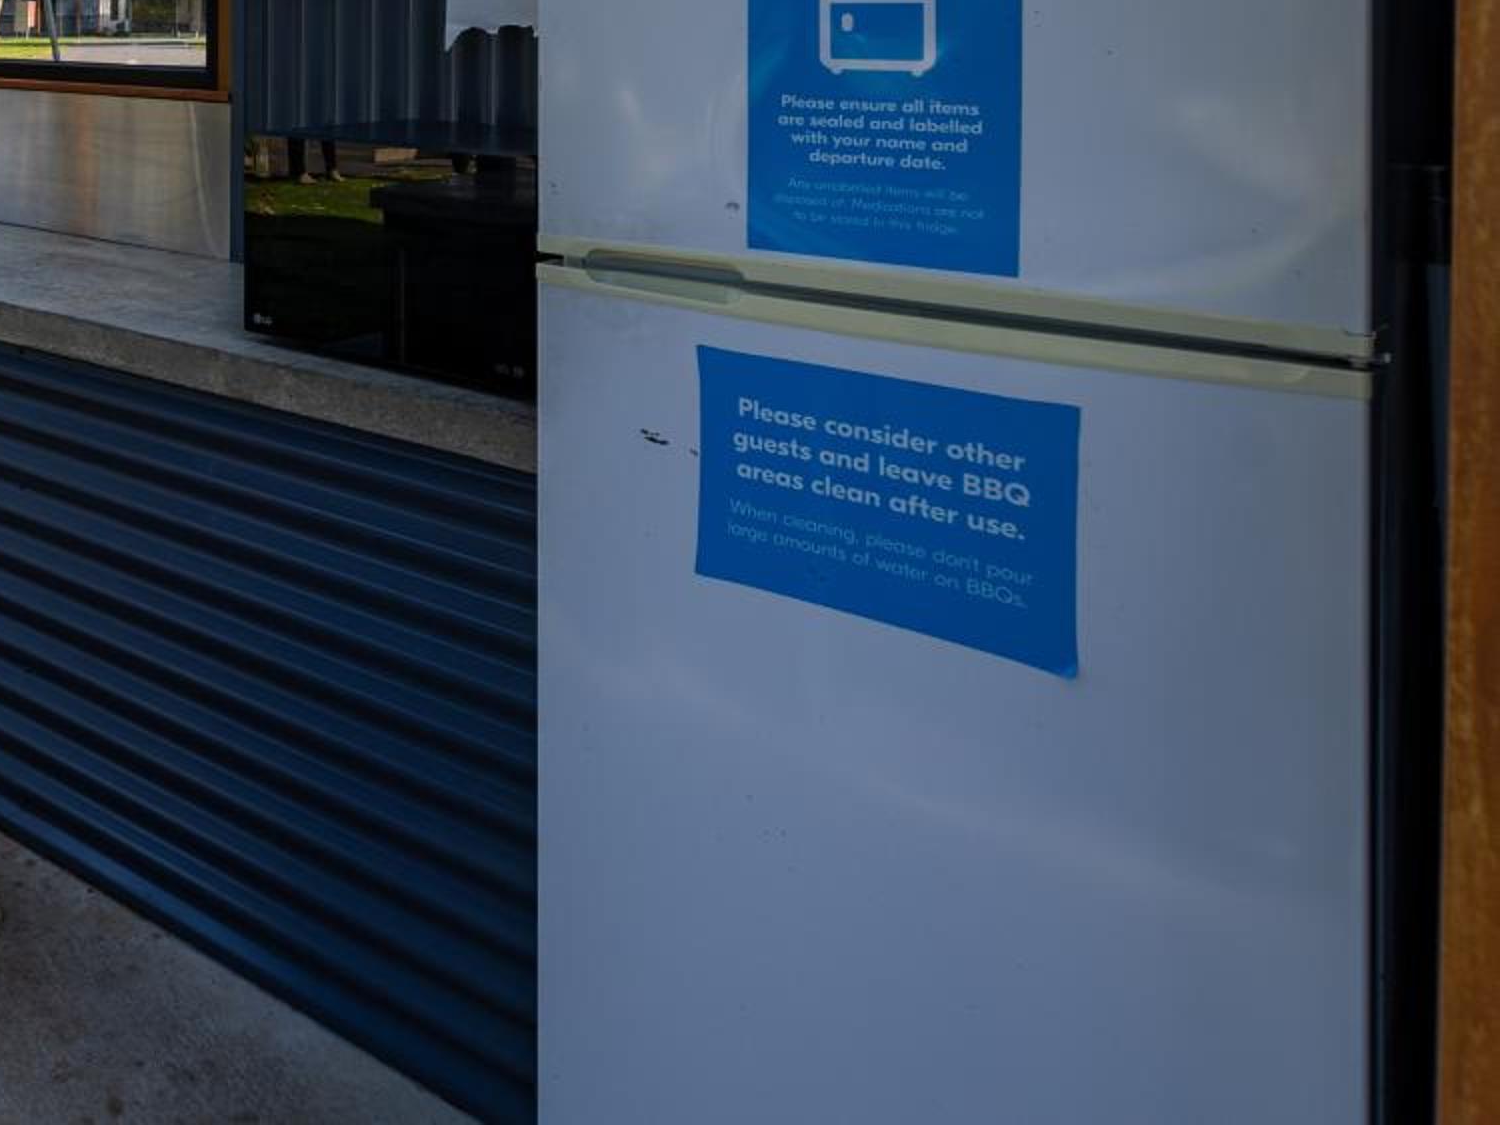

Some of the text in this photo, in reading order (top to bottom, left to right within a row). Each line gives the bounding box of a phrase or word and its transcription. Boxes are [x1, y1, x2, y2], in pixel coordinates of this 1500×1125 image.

[778, 115, 982, 135] are sealed and labelled
[782, 95, 979, 116] Please ensure all items
[791, 131, 967, 153] with your name and
[809, 150, 946, 170] departure date.
[739, 397, 1026, 473] Please consider other
[733, 431, 1030, 507] guests and leave BBQ
[737, 461, 1025, 541] areas clean after use.
[728, 522, 767, 542] large
[773, 534, 846, 561] amounts
[853, 553, 869, 565] of
[876, 557, 928, 579] water
[934, 575, 959, 588] on
[730, 499, 1031, 585] When cleaning, please don't pour
